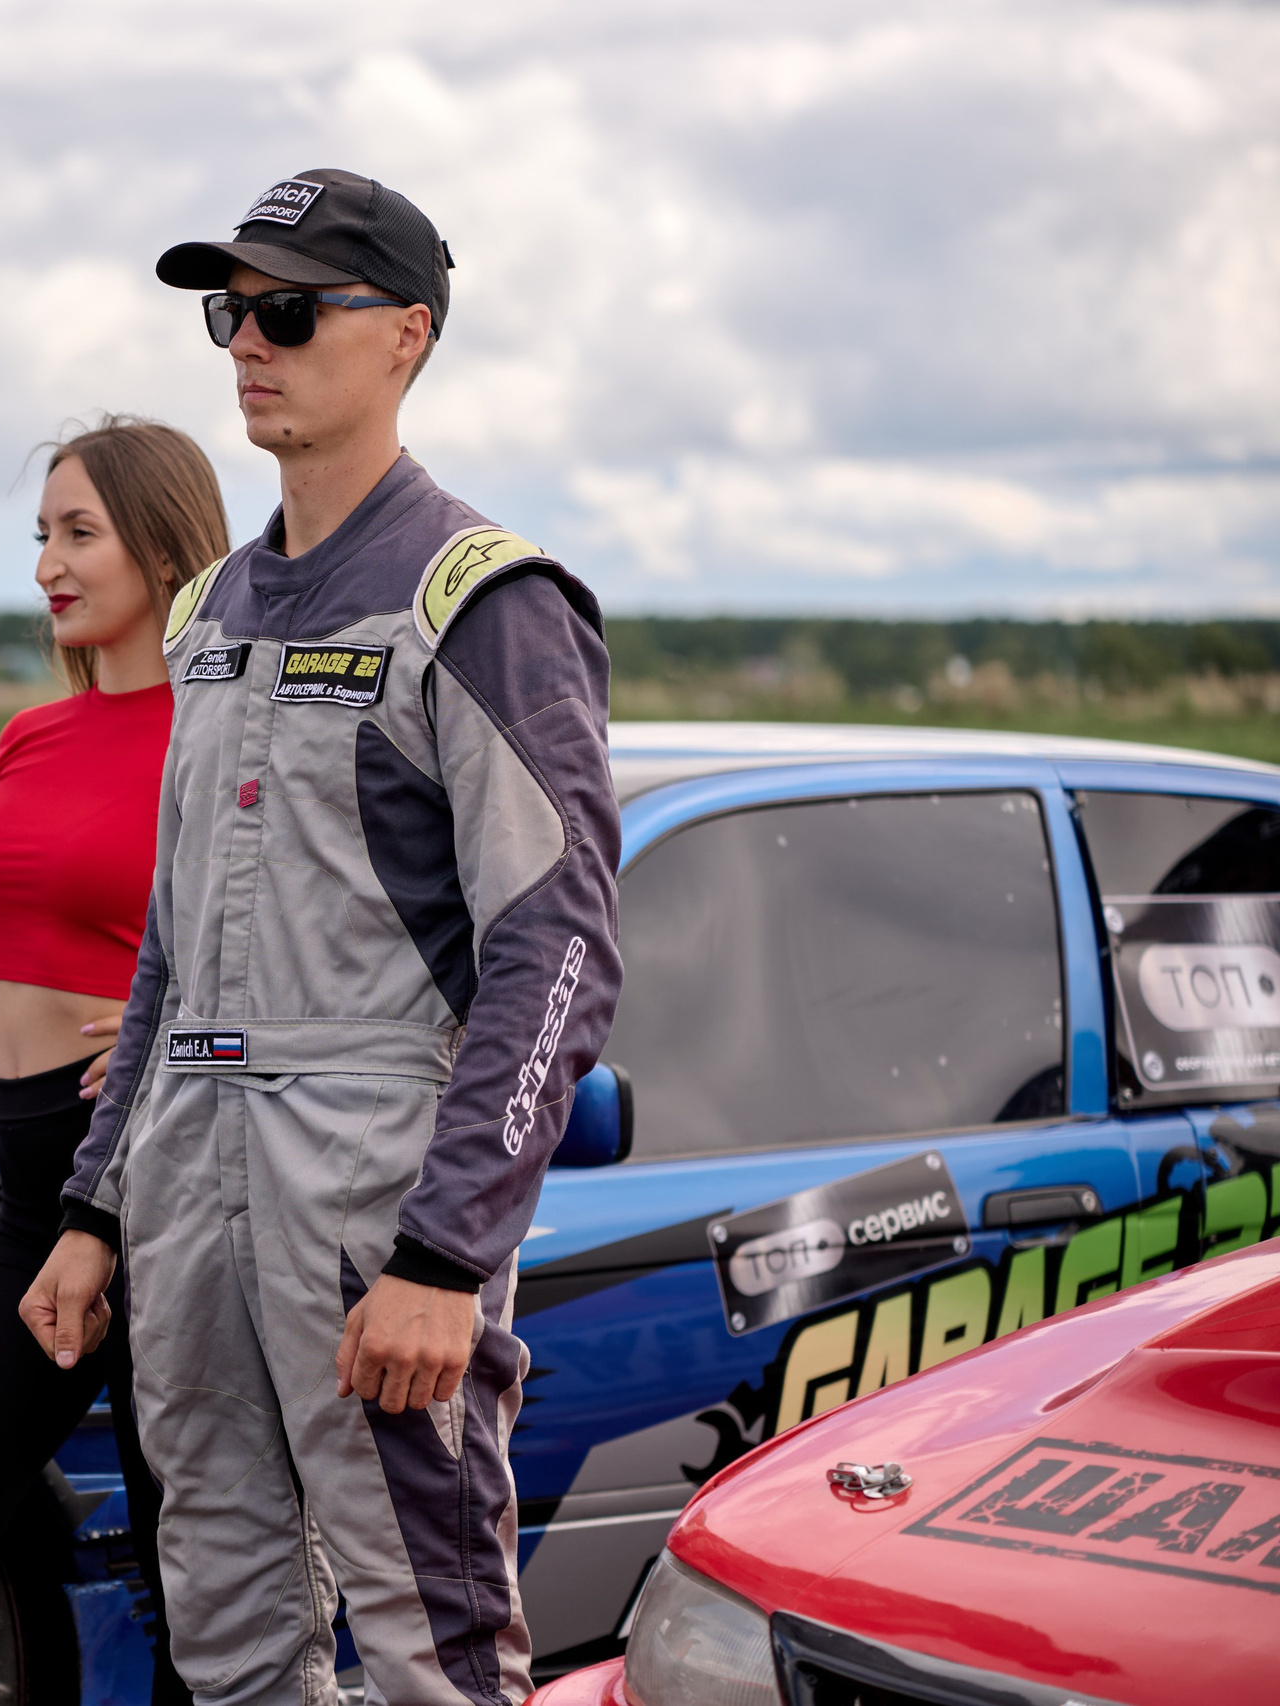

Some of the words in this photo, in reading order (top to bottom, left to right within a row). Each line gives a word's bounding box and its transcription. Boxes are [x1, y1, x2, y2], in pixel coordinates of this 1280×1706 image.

[200, 651, 228, 663] Zenich
[285, 653, 354, 675] GARAGE
[353, 655, 381, 677] 22
[277, 683, 328, 696] АВТОСЕРВИС
[1160, 965, 1253, 1010] ТОП
[170, 1039, 194, 1058] Zenich
[745, 1239, 809, 1280] ТОП
[848, 1190, 951, 1246] сервис
